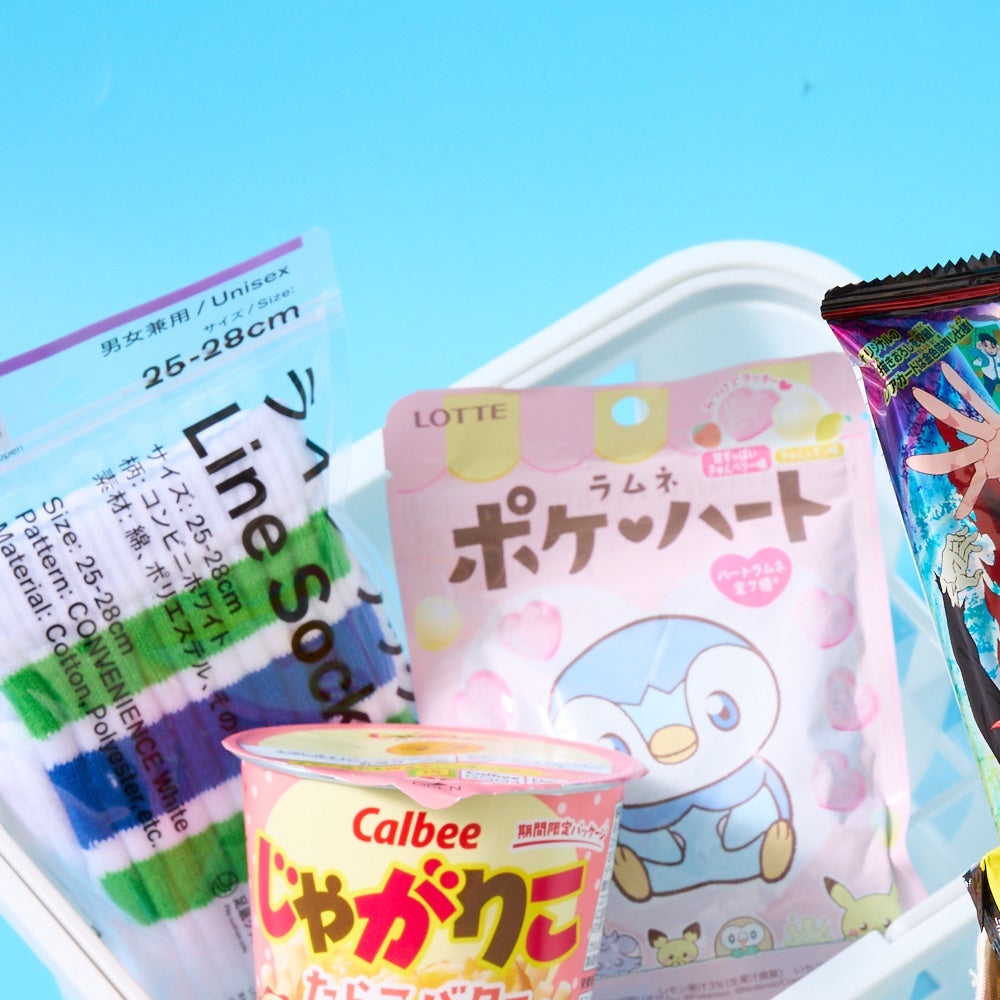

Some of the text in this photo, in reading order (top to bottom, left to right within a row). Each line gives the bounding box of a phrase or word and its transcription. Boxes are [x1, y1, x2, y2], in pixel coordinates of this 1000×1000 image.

[142, 305, 301, 390] 25-28cm
[414, 403, 508, 429] LOTTE
[449, 471, 832, 590] ポケ ハート
[589, 468, 678, 497] ラムネ
[43, 496, 135, 656] Size: 25-28cm
[183, 402, 289, 562] Line
[268, 563, 376, 724] Sock
[16, 508, 189, 833] Pattern: CONVENIENCE White
[353, 807, 482, 849] Calbee
[517, 820, 609, 841] 期間限定パッケージ
[255, 831, 588, 969] じゃがりこ
